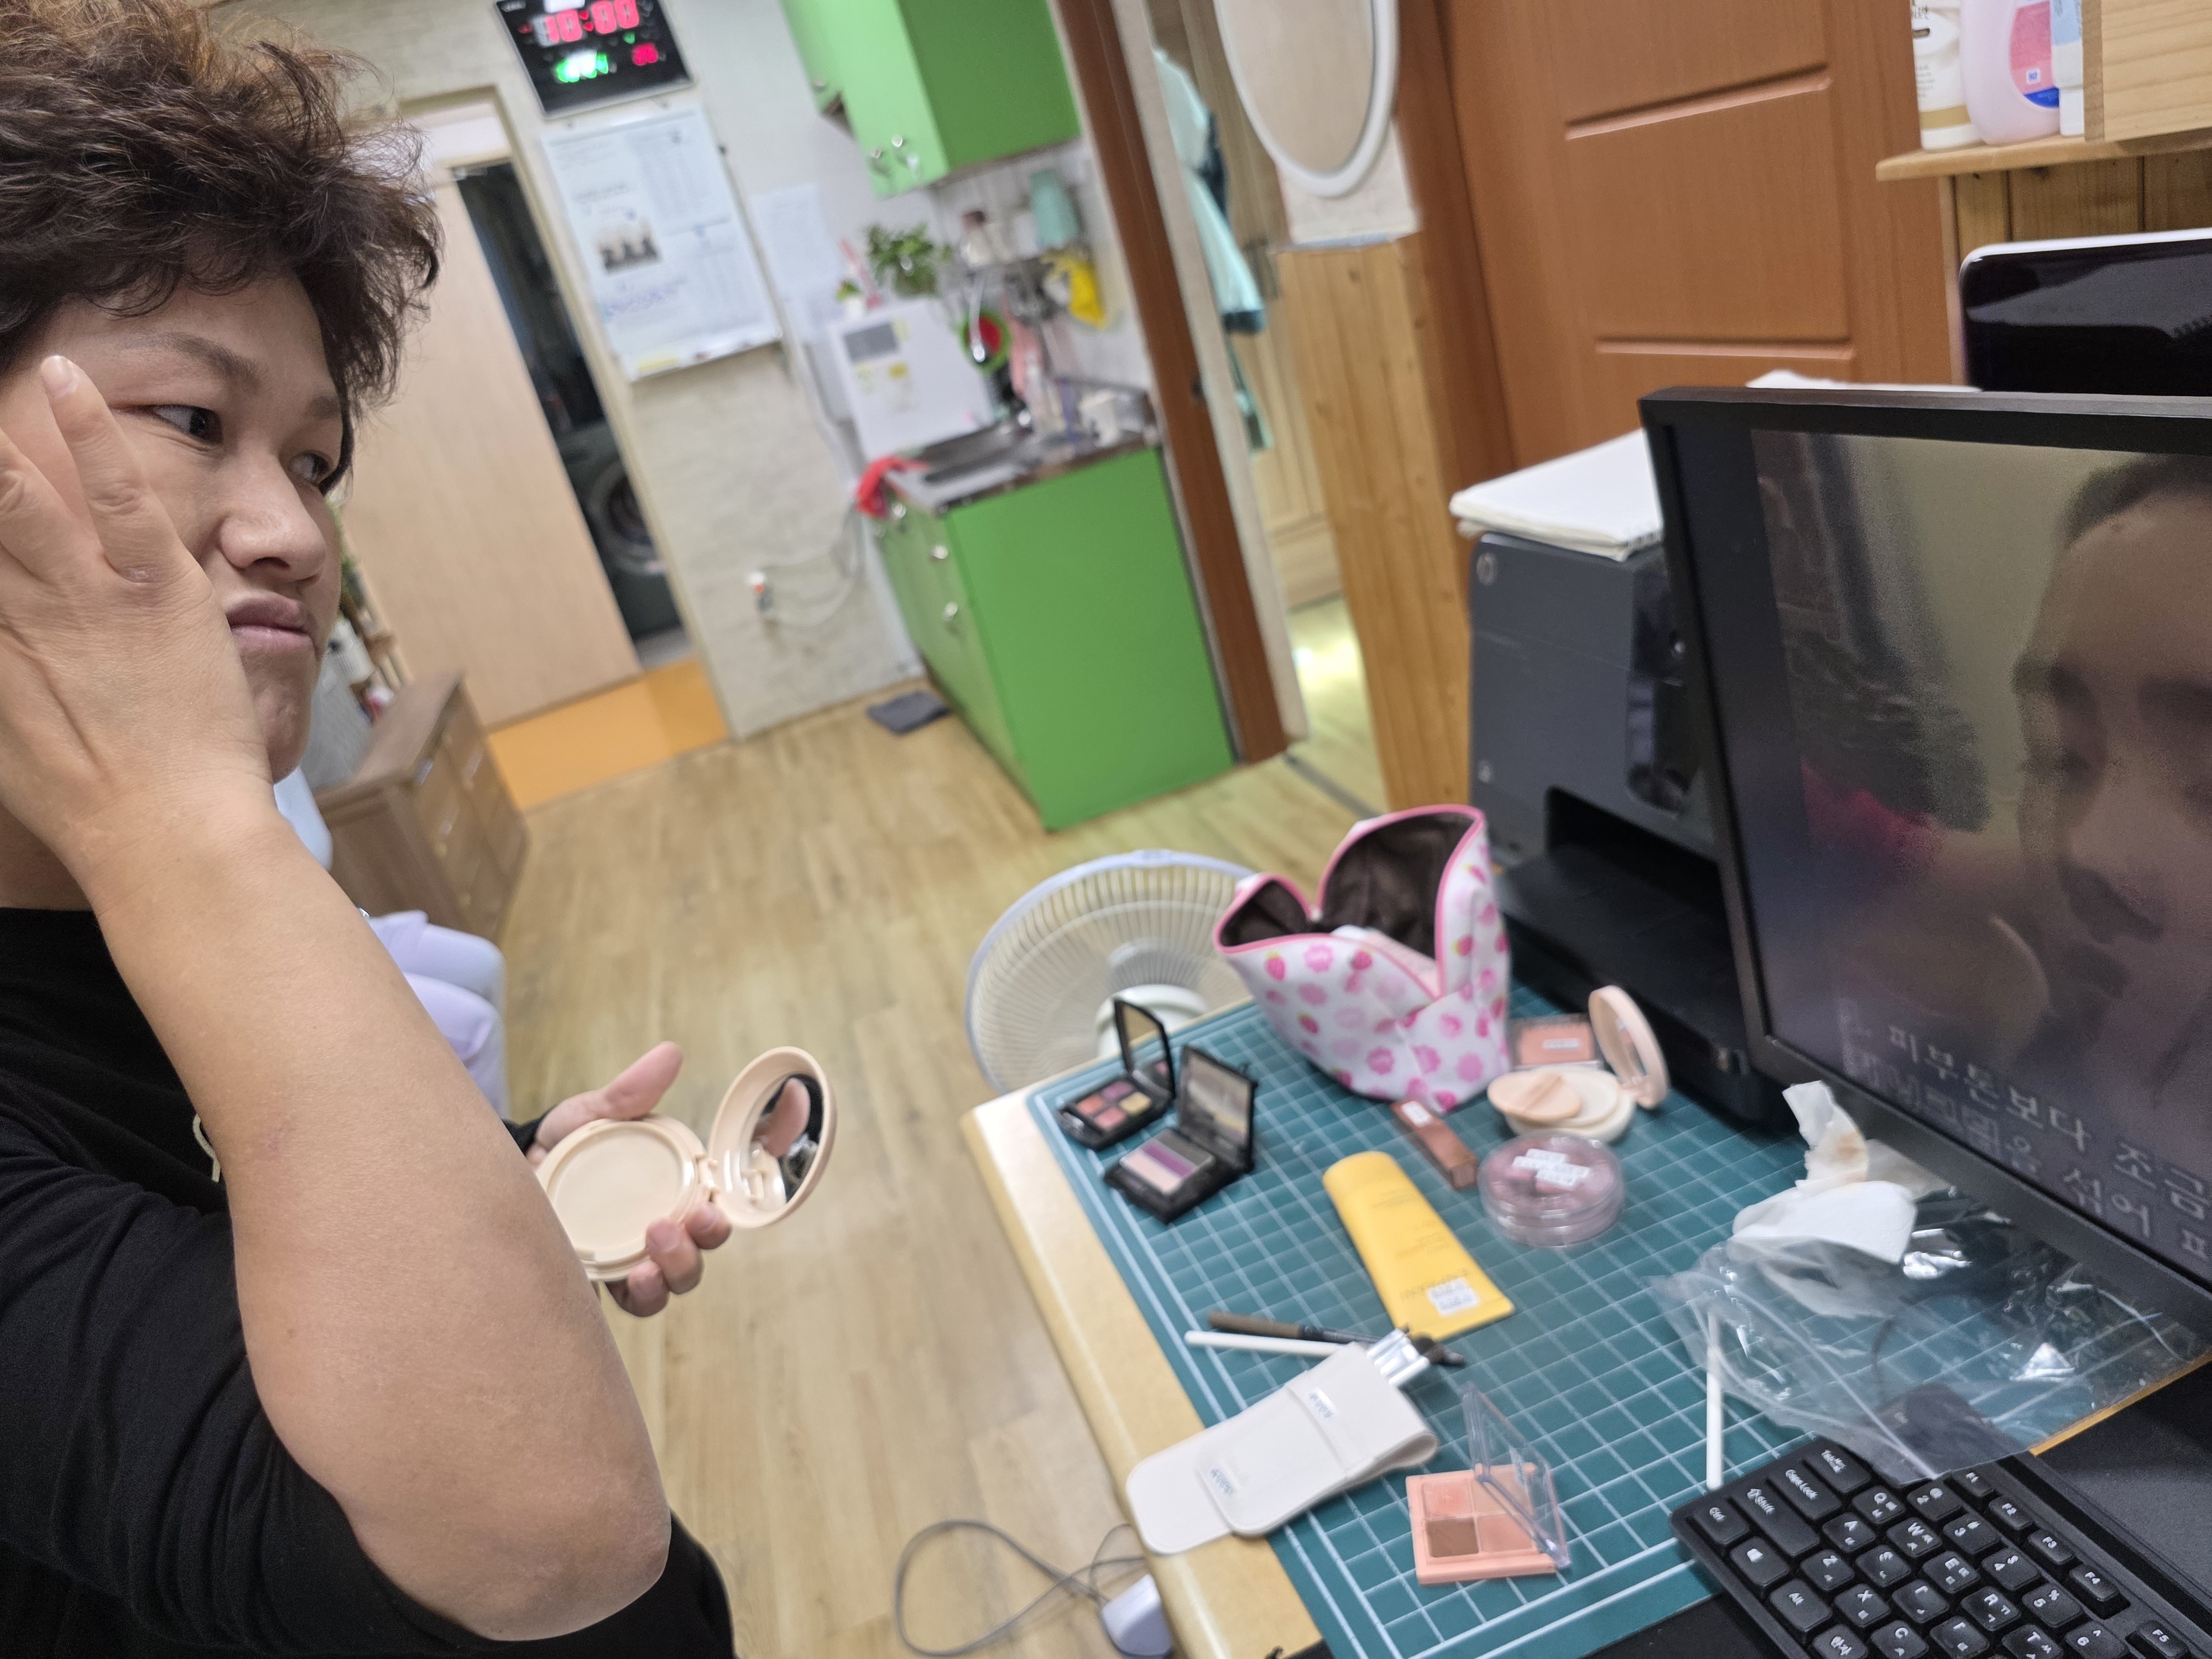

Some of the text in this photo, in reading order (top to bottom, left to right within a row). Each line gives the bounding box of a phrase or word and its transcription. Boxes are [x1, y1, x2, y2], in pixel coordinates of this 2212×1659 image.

[1888, 1024, 2211, 1220] 피부톤보다 조금
[1874, 1492, 1887, 1505] Q
[1844, 1520, 1858, 1531] A
[1907, 1522, 1925, 1536] W
[1944, 1558, 1960, 1570] E
[1857, 1590, 1873, 1603] X
[2033, 1598, 2046, 1608] 5
[1895, 1627, 1908, 1639] C
[2027, 1631, 2041, 1642] T
[2152, 1629, 2169, 1642] F5
[2077, 1636, 2089, 1646] 6
